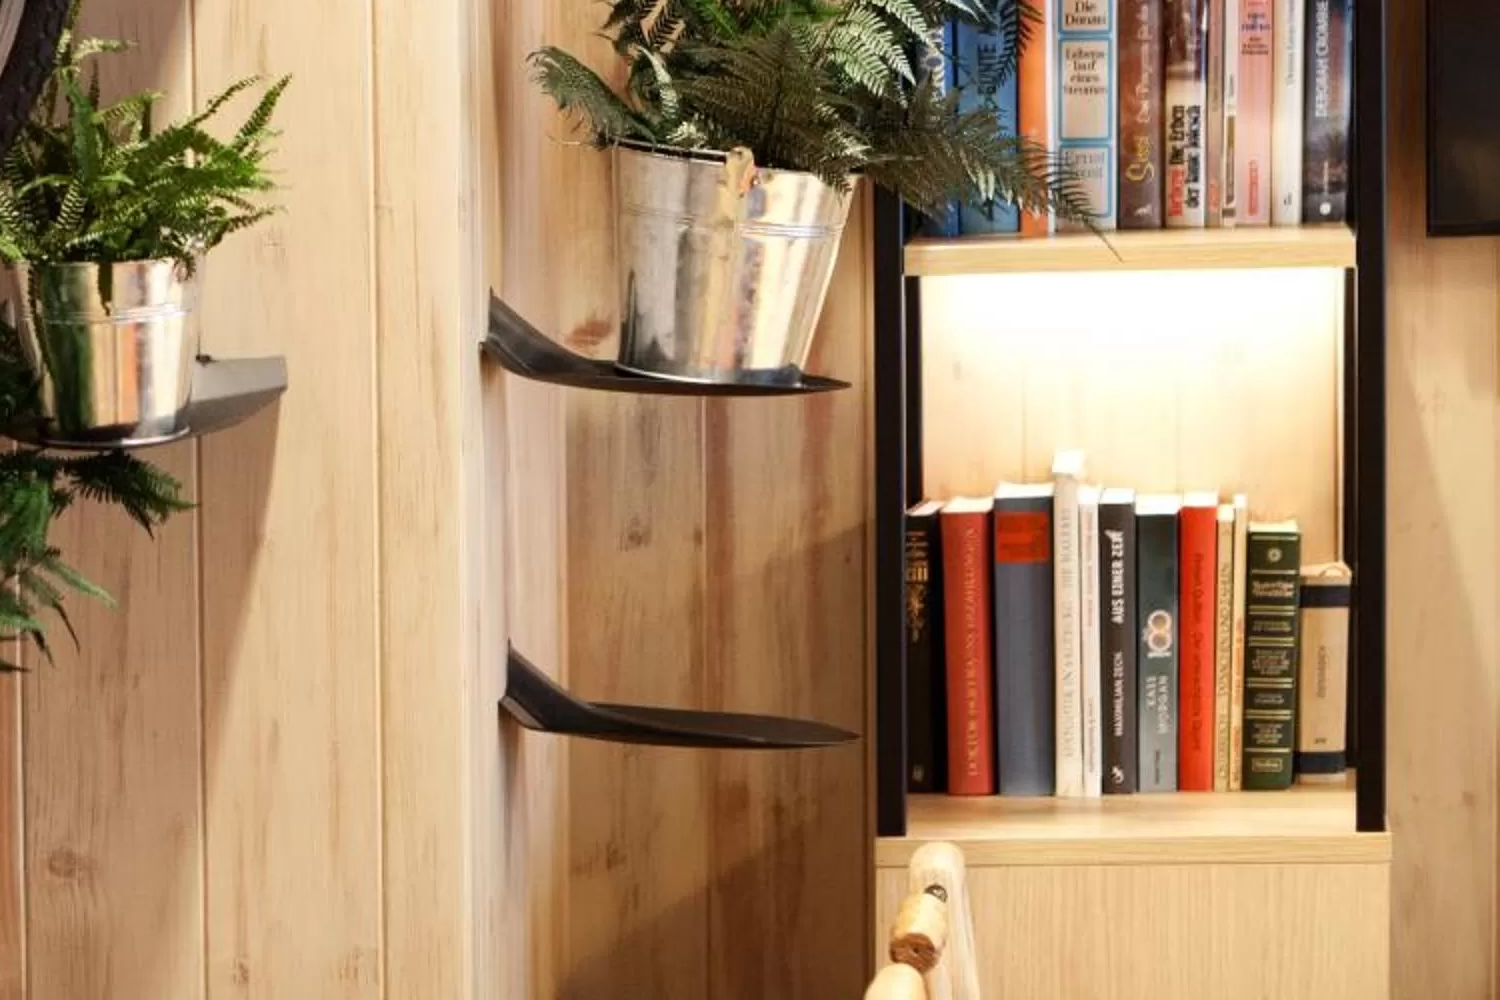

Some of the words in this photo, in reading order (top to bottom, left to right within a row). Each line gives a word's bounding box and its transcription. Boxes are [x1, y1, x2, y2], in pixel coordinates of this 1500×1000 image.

[1074, 0, 1096, 12] Die
[1315, 59, 1329, 118] DEBORAH
[1168, 105, 1184, 141] Erben
[1111, 559, 1124, 596] EINER
[1110, 599, 1124, 625] AUS
[1112, 679, 1125, 736] MAXIMILIAN
[1156, 675, 1171, 734] MORGAN
